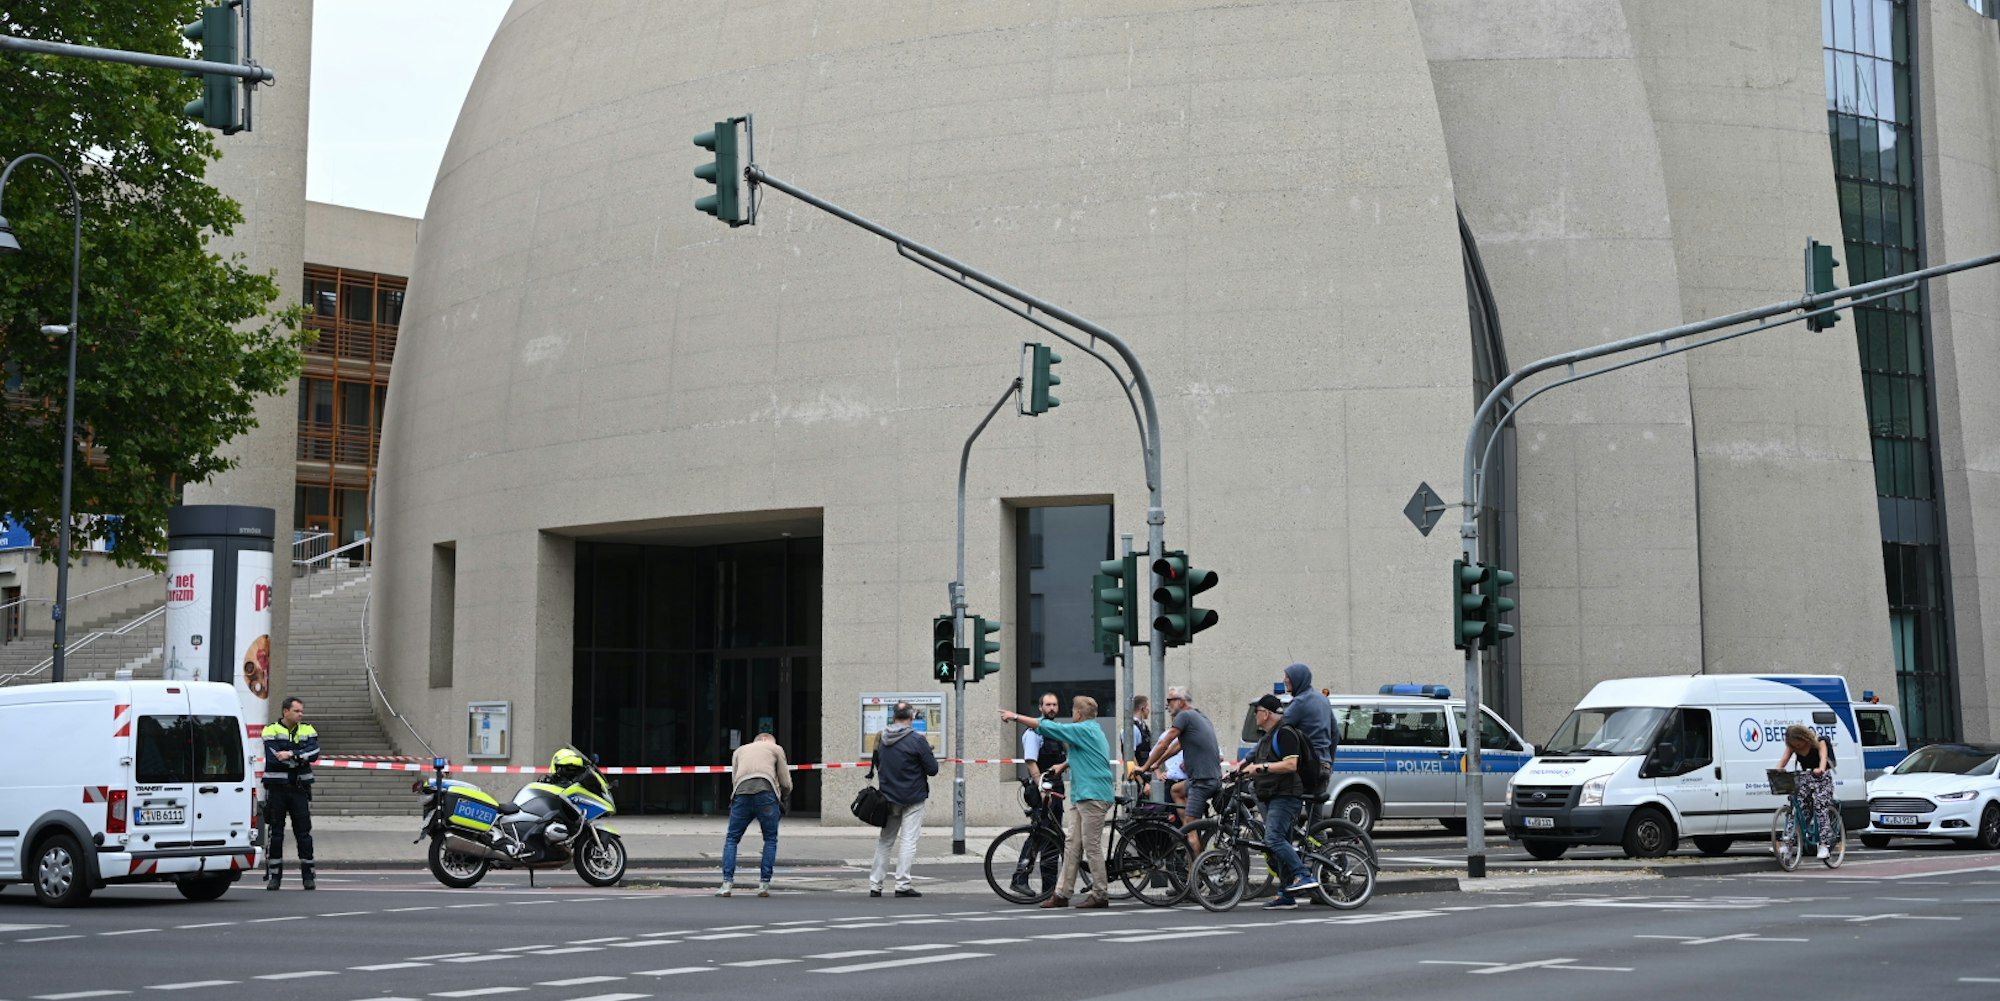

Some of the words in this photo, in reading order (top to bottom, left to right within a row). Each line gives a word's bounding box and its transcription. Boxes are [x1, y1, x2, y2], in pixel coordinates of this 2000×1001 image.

[176, 573, 194, 588] net
[1396, 760, 1442, 772] POLIZEI
[458, 804, 493, 822] POLIZEI
